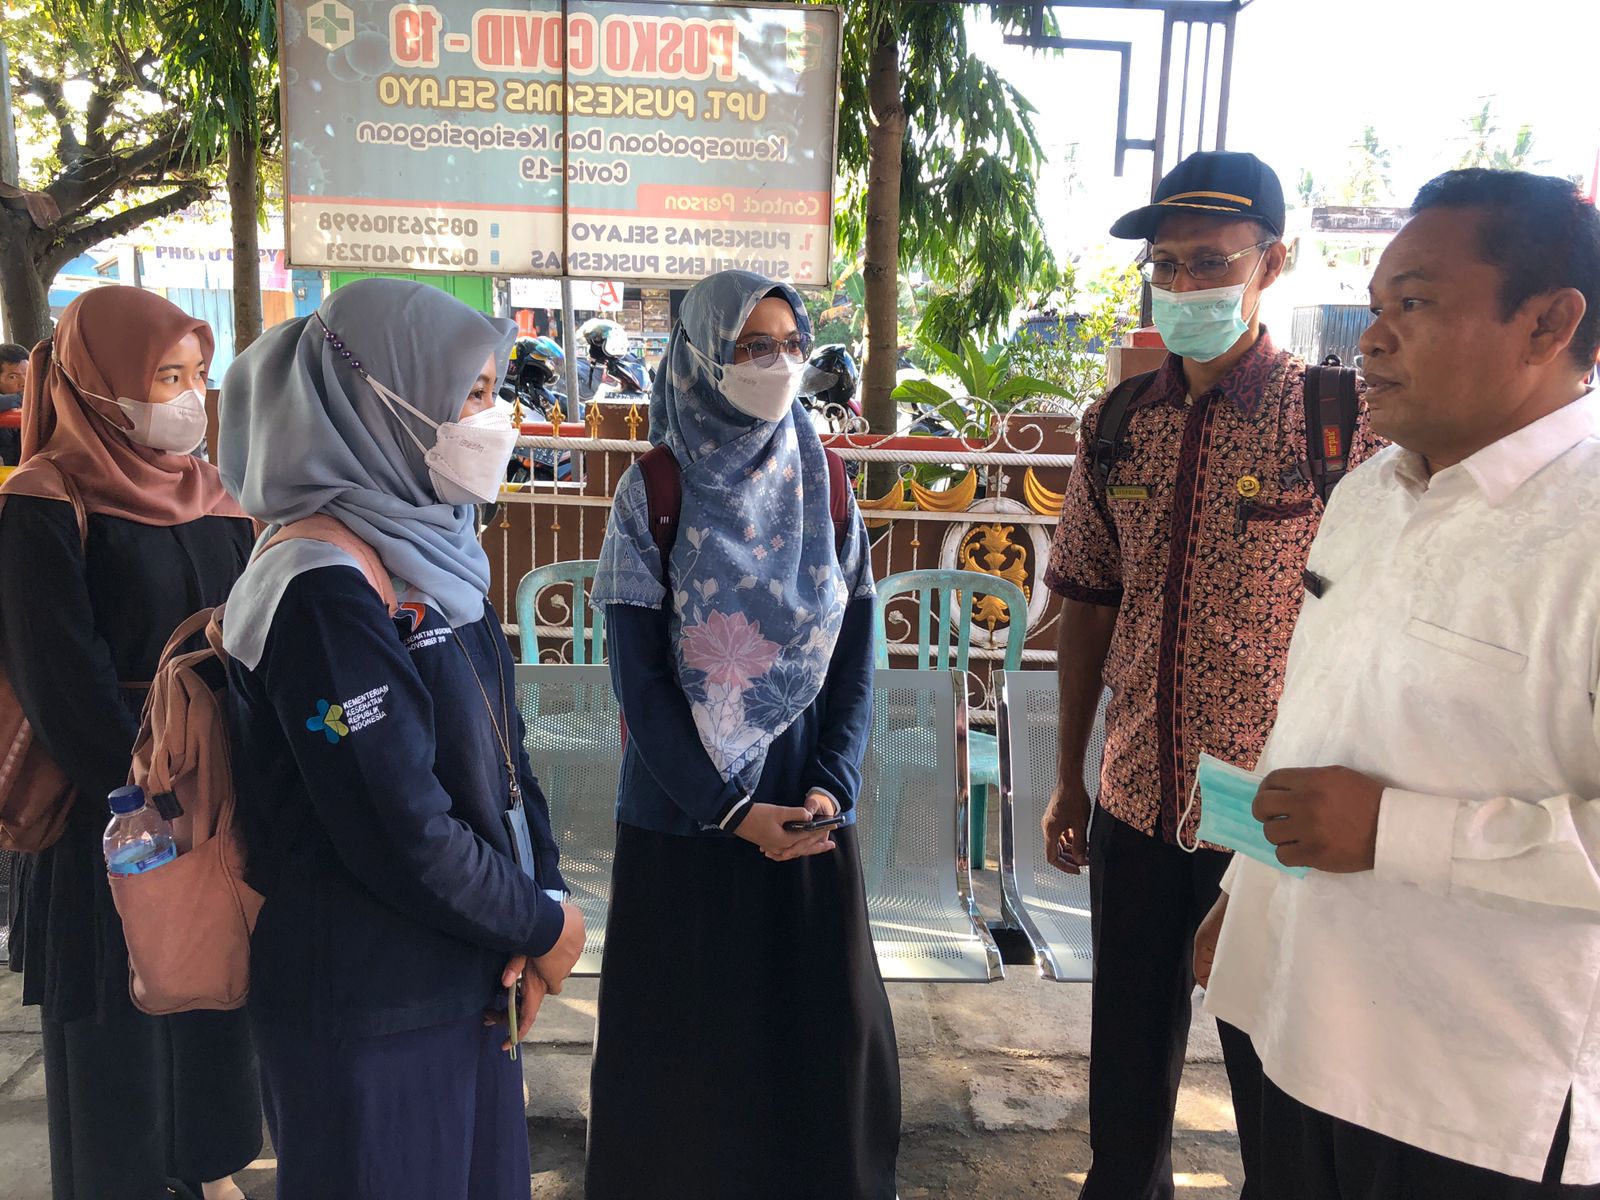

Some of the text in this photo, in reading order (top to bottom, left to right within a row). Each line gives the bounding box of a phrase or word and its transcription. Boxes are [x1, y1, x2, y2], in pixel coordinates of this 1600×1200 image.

[226, 248, 279, 262] CPY
[405, 629, 434, 644] SEHATAN
[343, 684, 389, 709] KEMENTERIAN
[346, 696, 383, 718] KESEHATAN
[348, 706, 380, 724] REPUBLIK
[351, 711, 387, 732] INDONESIA
